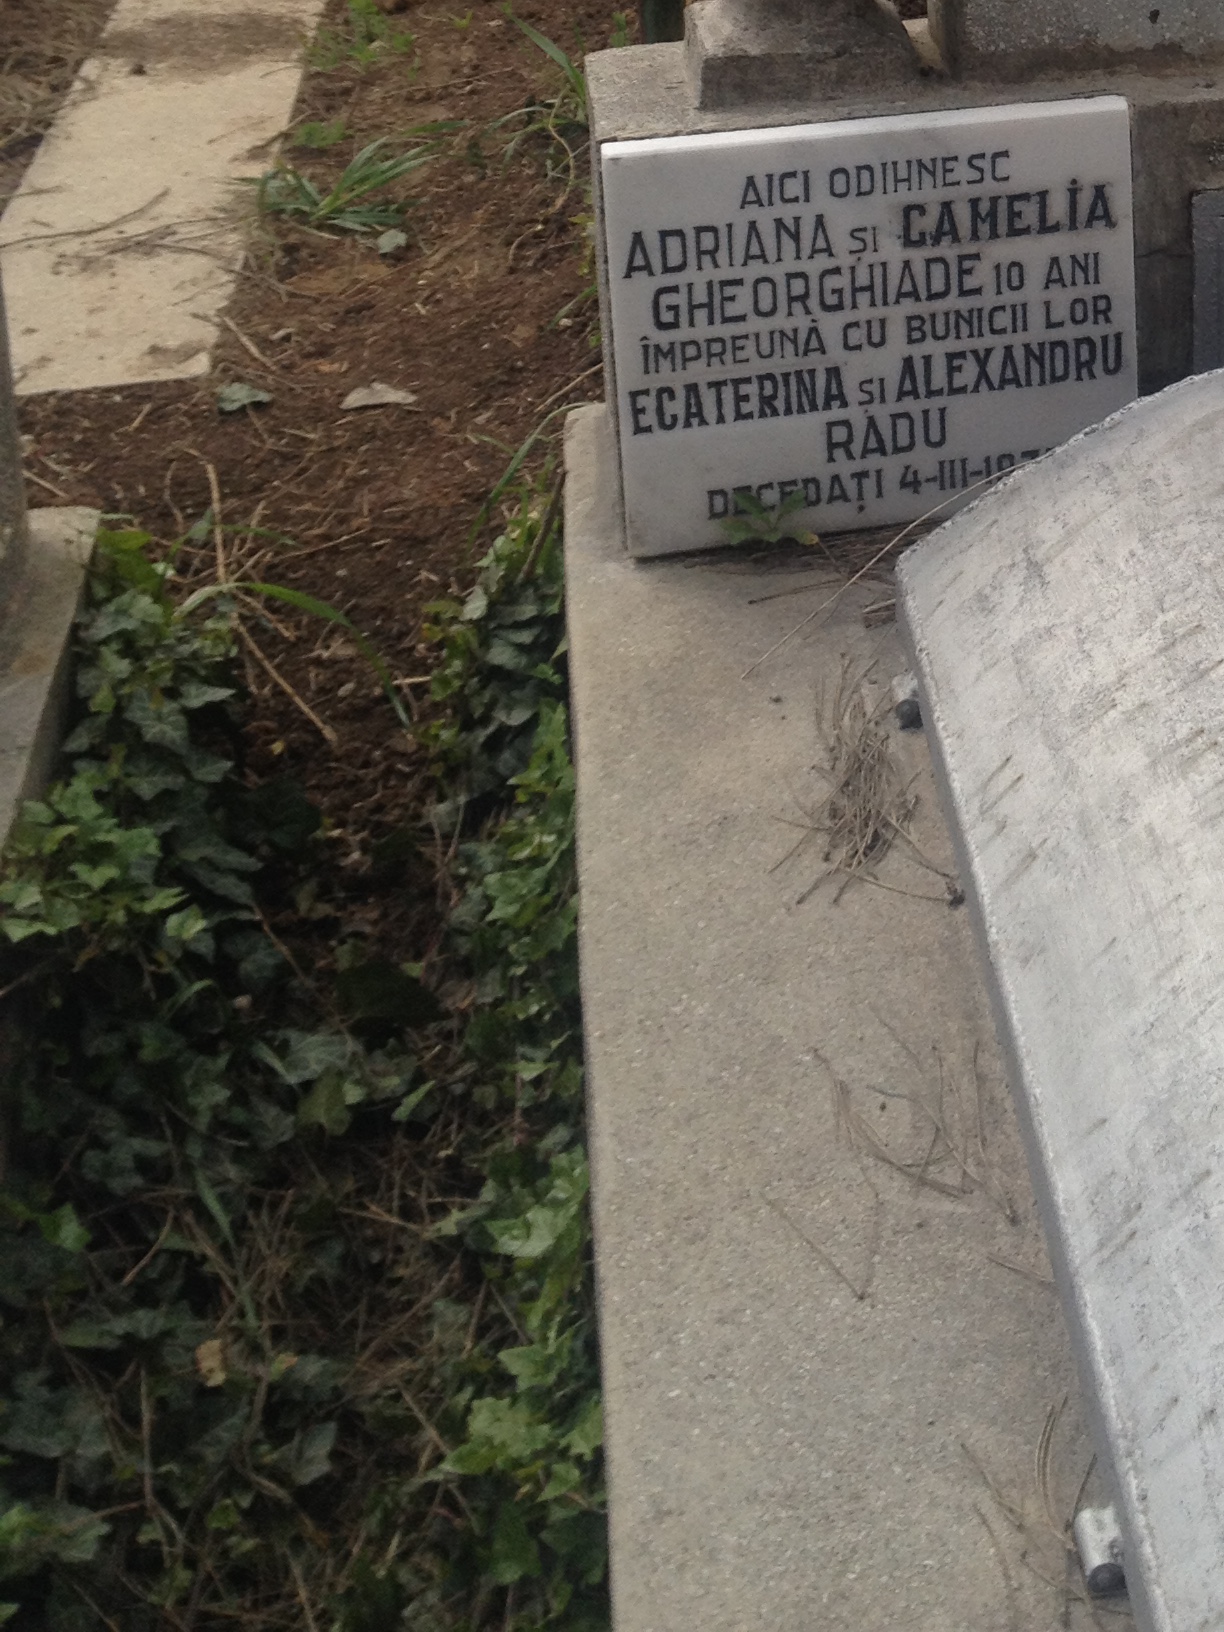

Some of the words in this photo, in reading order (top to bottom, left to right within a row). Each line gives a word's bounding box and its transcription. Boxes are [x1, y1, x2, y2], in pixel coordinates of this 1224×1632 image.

[739, 170, 812, 210] AICI
[828, 150, 1012, 199] ODIHNESC
[622, 214, 836, 279] ADRIANA
[651, 252, 983, 331] GHEORGHIADE
[993, 260, 1026, 296] 10
[1043, 252, 1102, 291] ANI
[842, 317, 888, 352] CU
[906, 302, 1029, 345] BUNICII
[1043, 293, 1114, 330] LOR
[628, 365, 849, 436] ECATERINA
[893, 332, 1124, 403] ALEXANDRU
[825, 408, 949, 463] RADU
